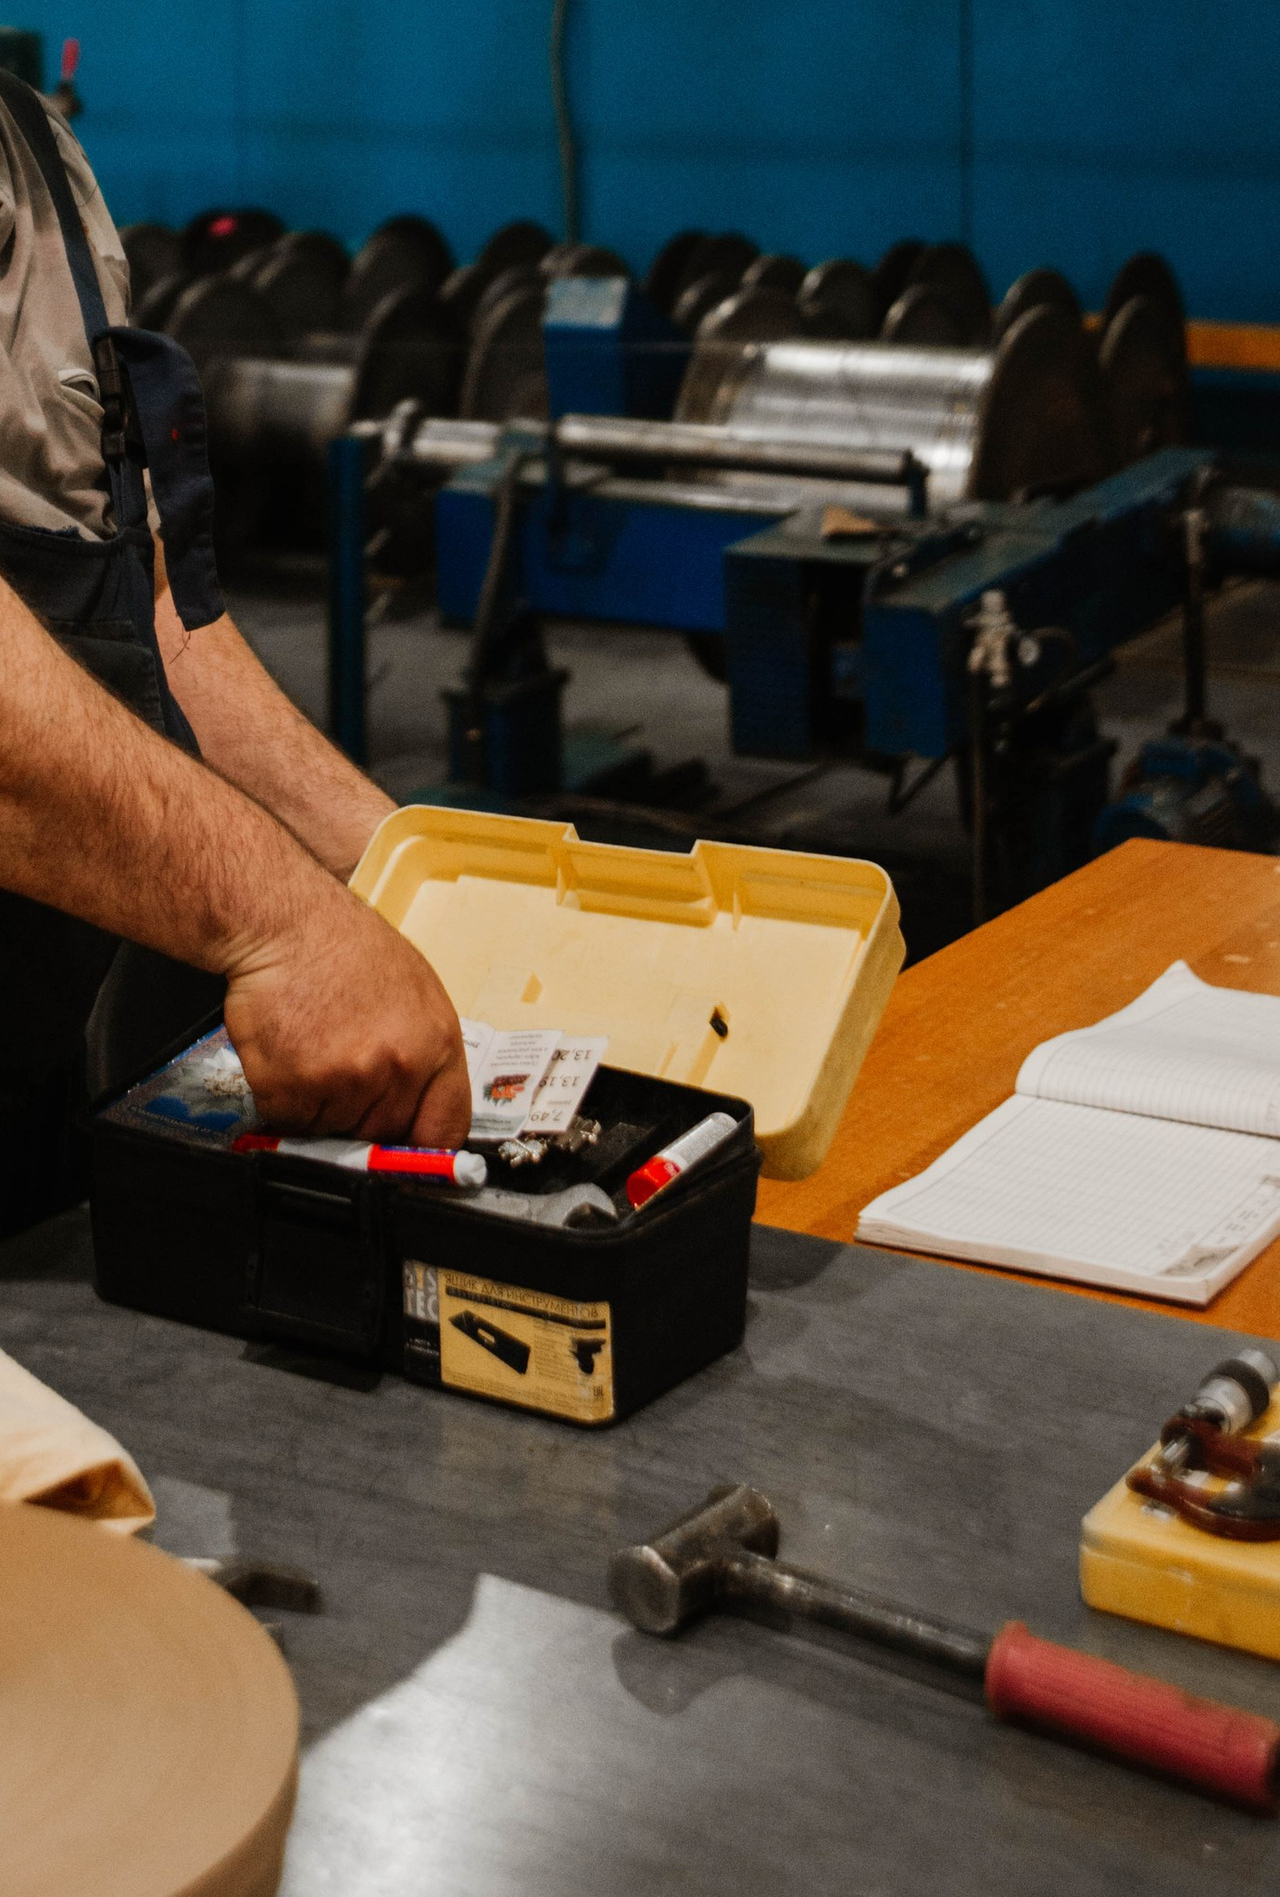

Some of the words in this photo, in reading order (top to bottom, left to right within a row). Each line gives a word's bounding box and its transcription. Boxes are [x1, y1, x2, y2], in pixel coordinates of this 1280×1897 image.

[445, 1274, 477, 1291] ЯЩИК
[481, 1283, 505, 1297] ДЛЯ
[505, 1285, 599, 1318] ИНСТРУМЕНТОВ
